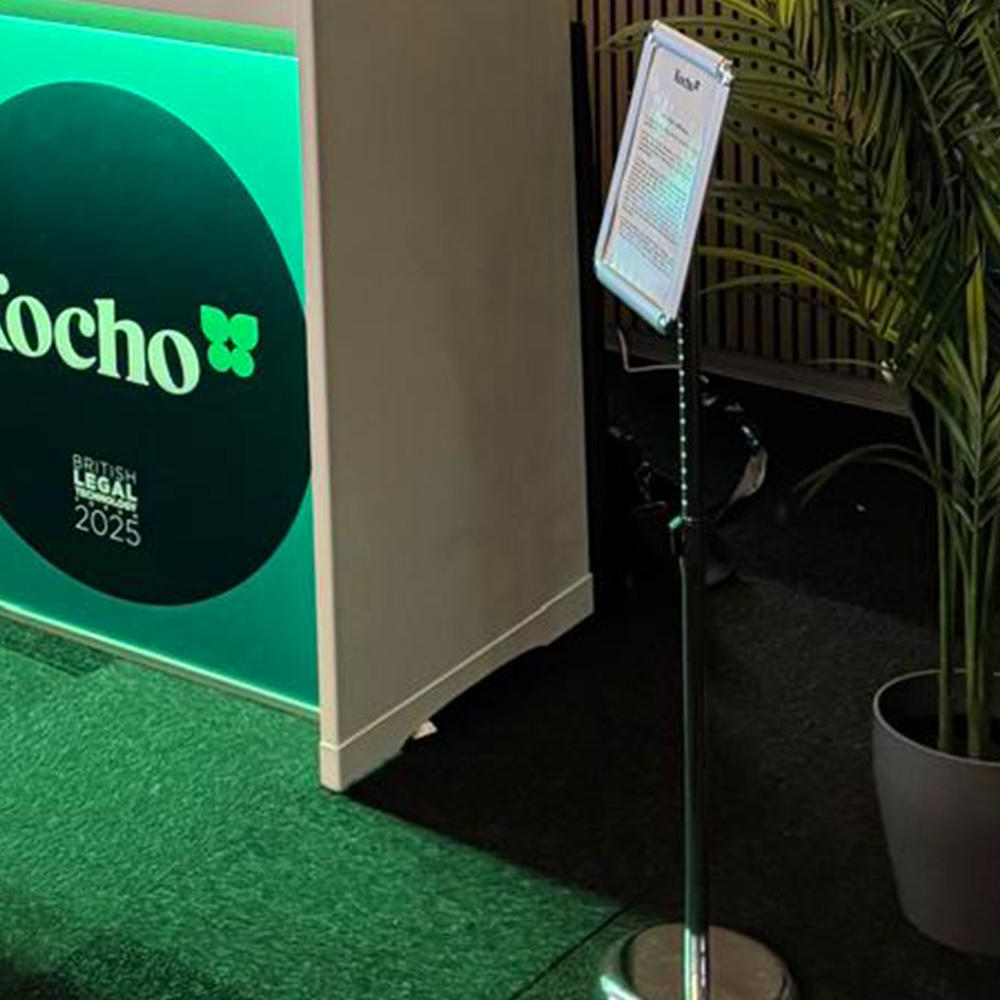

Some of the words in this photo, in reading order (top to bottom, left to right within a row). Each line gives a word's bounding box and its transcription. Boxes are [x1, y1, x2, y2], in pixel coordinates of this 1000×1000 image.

[73, 453, 137, 485] BRITISH
[74, 469, 138, 501] LEGAL
[75, 504, 141, 547] 2025
